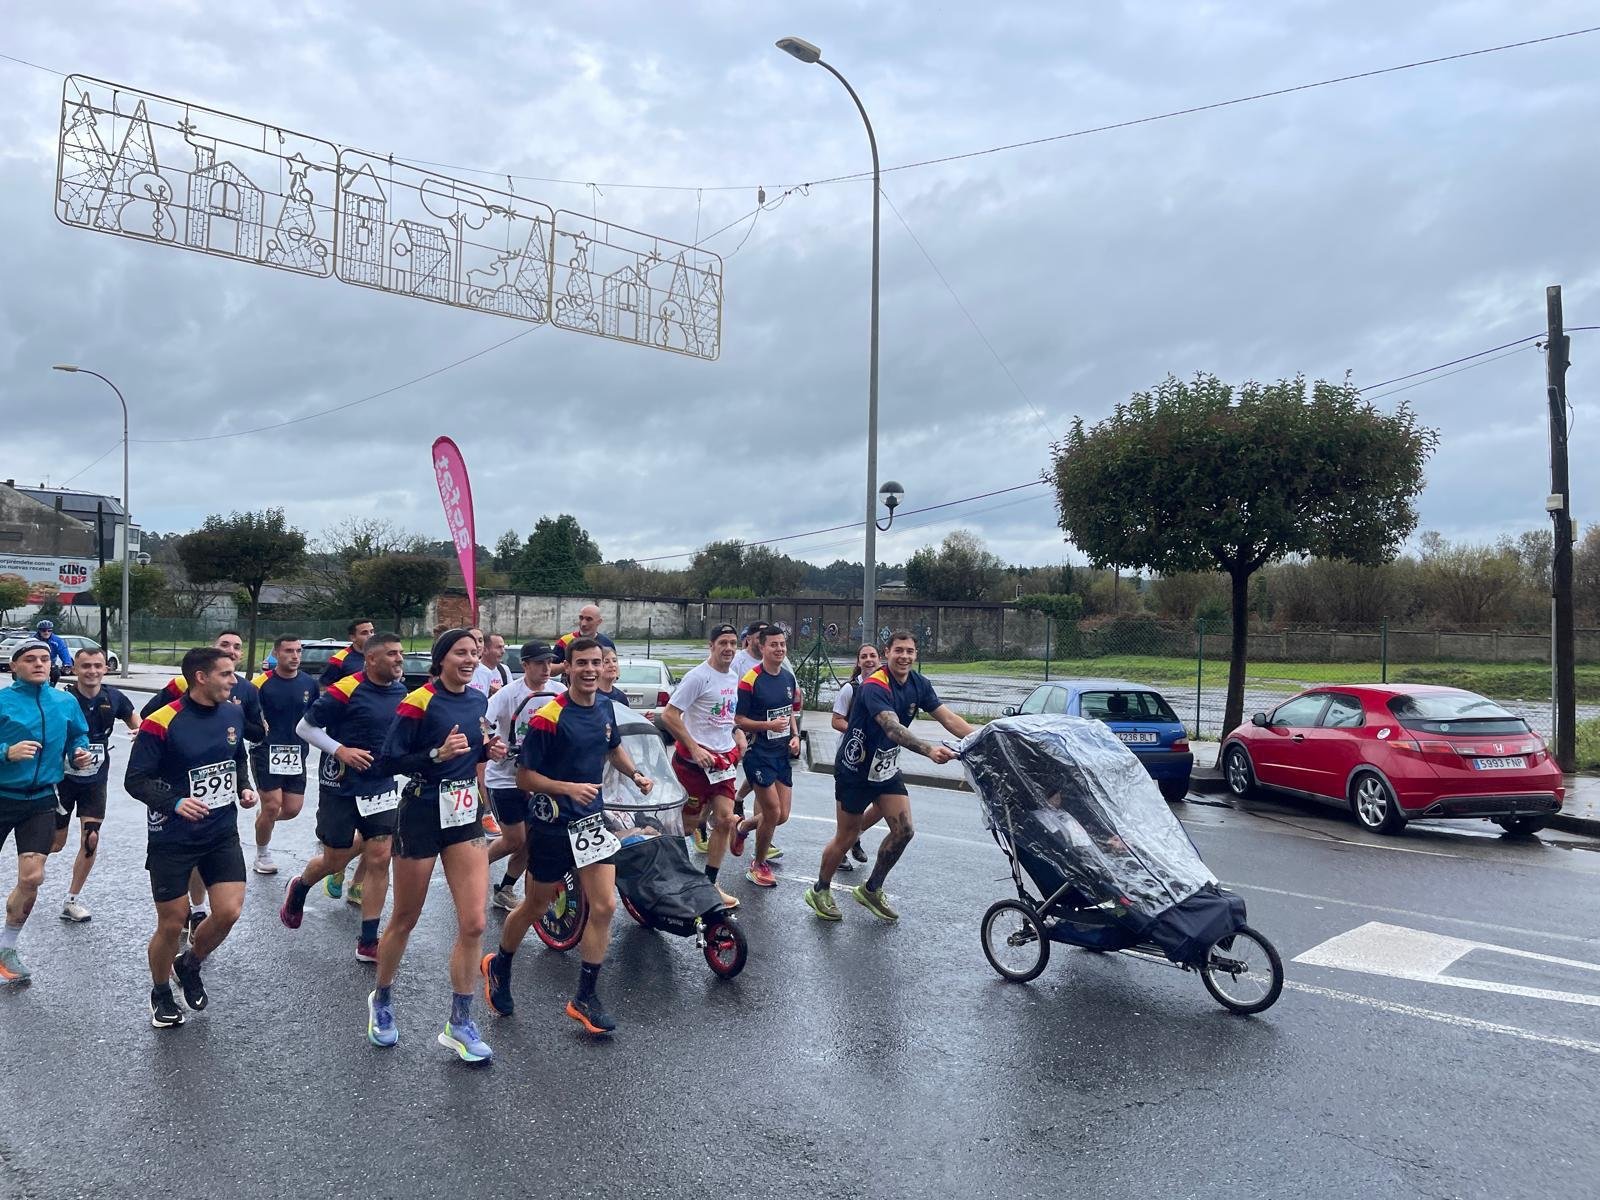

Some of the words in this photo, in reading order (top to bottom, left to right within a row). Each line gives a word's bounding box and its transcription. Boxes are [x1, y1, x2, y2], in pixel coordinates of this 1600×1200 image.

[59, 564, 87, 575] KING
[1139, 733, 1153, 742] BLT
[271, 753, 299, 766] 642
[1480, 759, 1505, 769] 5993
[1505, 758, 1523, 768] FNP
[192, 772, 233, 798] 598
[575, 826, 606, 852] 63
